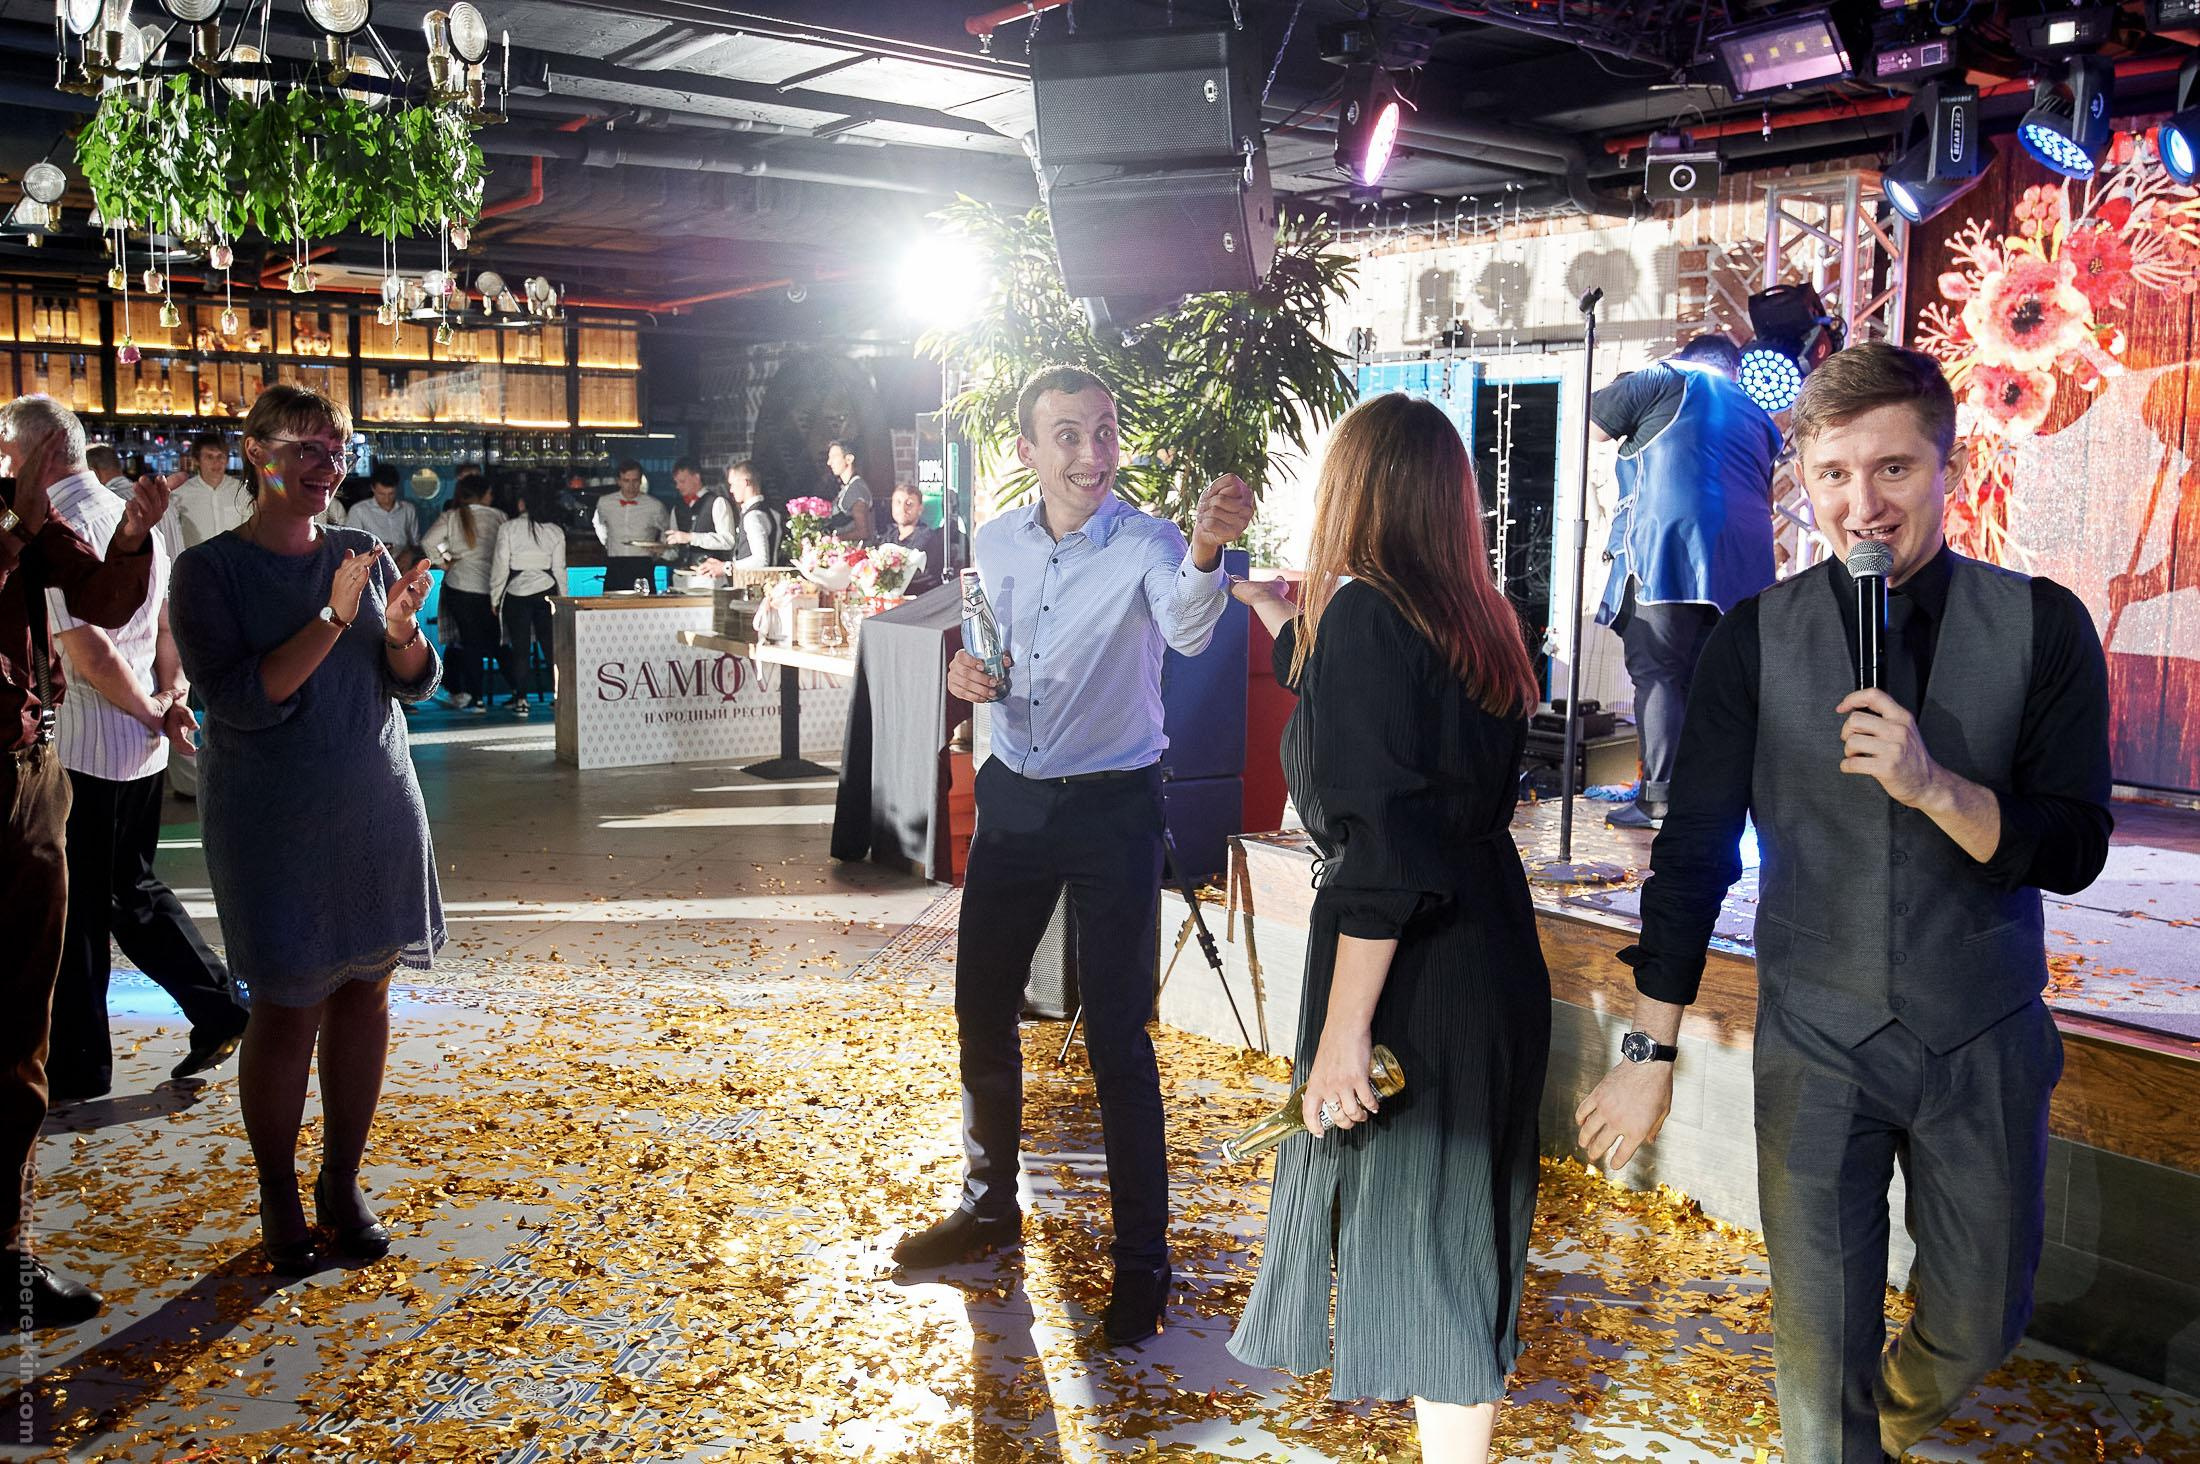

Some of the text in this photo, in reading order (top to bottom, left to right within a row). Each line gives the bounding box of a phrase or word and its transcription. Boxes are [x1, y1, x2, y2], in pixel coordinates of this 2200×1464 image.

[918, 459, 943, 482] 100%
[597, 652, 841, 704] SAMOV
[645, 704, 802, 724] НАРОДНЫЙ РЕСТО
